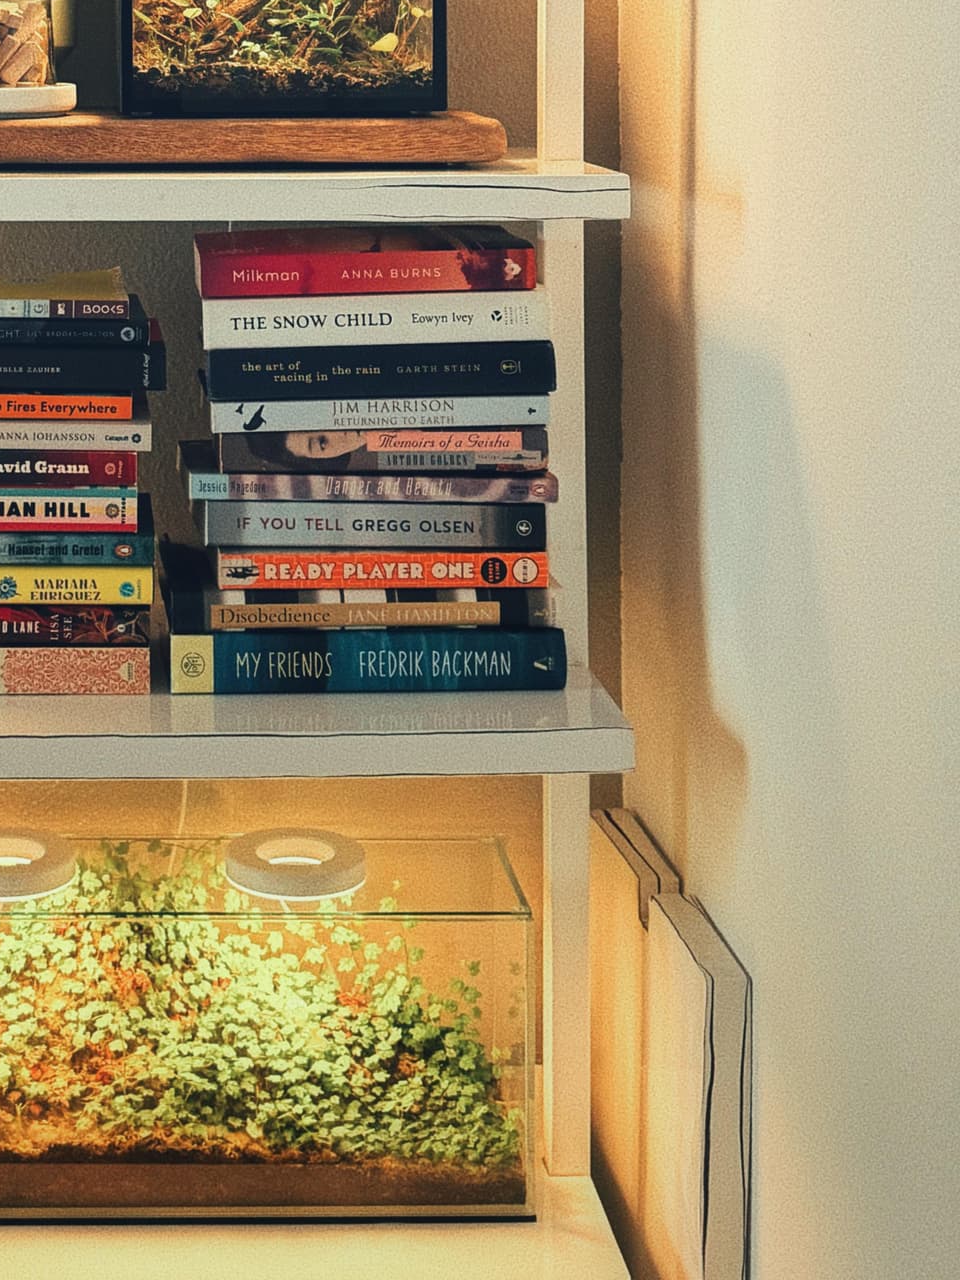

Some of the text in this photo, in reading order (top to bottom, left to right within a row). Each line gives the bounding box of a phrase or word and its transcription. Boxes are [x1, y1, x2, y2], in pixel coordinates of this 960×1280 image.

[232, 268, 300, 283] Milkman
[341, 266, 442, 280] ANNA BURNS
[230, 311, 393, 331] THE SNOW CHILD
[411, 312, 449, 327] Eowyn
[451, 310, 475, 326] Ivey
[241, 360, 302, 372] the art of
[331, 364, 382, 376] the rain
[273, 370, 329, 384] racing in
[5, 400, 36, 415] Fires
[40, 400, 118, 418] Everywhere
[331, 398, 456, 417] JIM HARRISON
[32, 431, 96, 443] JOHANSSON
[377, 433, 511, 451] Memoirs of a Geisha
[34, 460, 90, 475] Grann
[325, 476, 453, 498] Danger and Beauty
[43, 501, 91, 519] HILL
[236, 517, 345, 532] IF YOU TELL
[351, 518, 476, 534] GREGG OLSEN
[263, 561, 475, 581] READY PLAYER ONE
[219, 607, 332, 624] Disobedience
[13, 620, 41, 634] LANE
[235, 651, 334, 680] MY FRIENDS
[359, 651, 513, 679] FREDRIK BACKMAN
